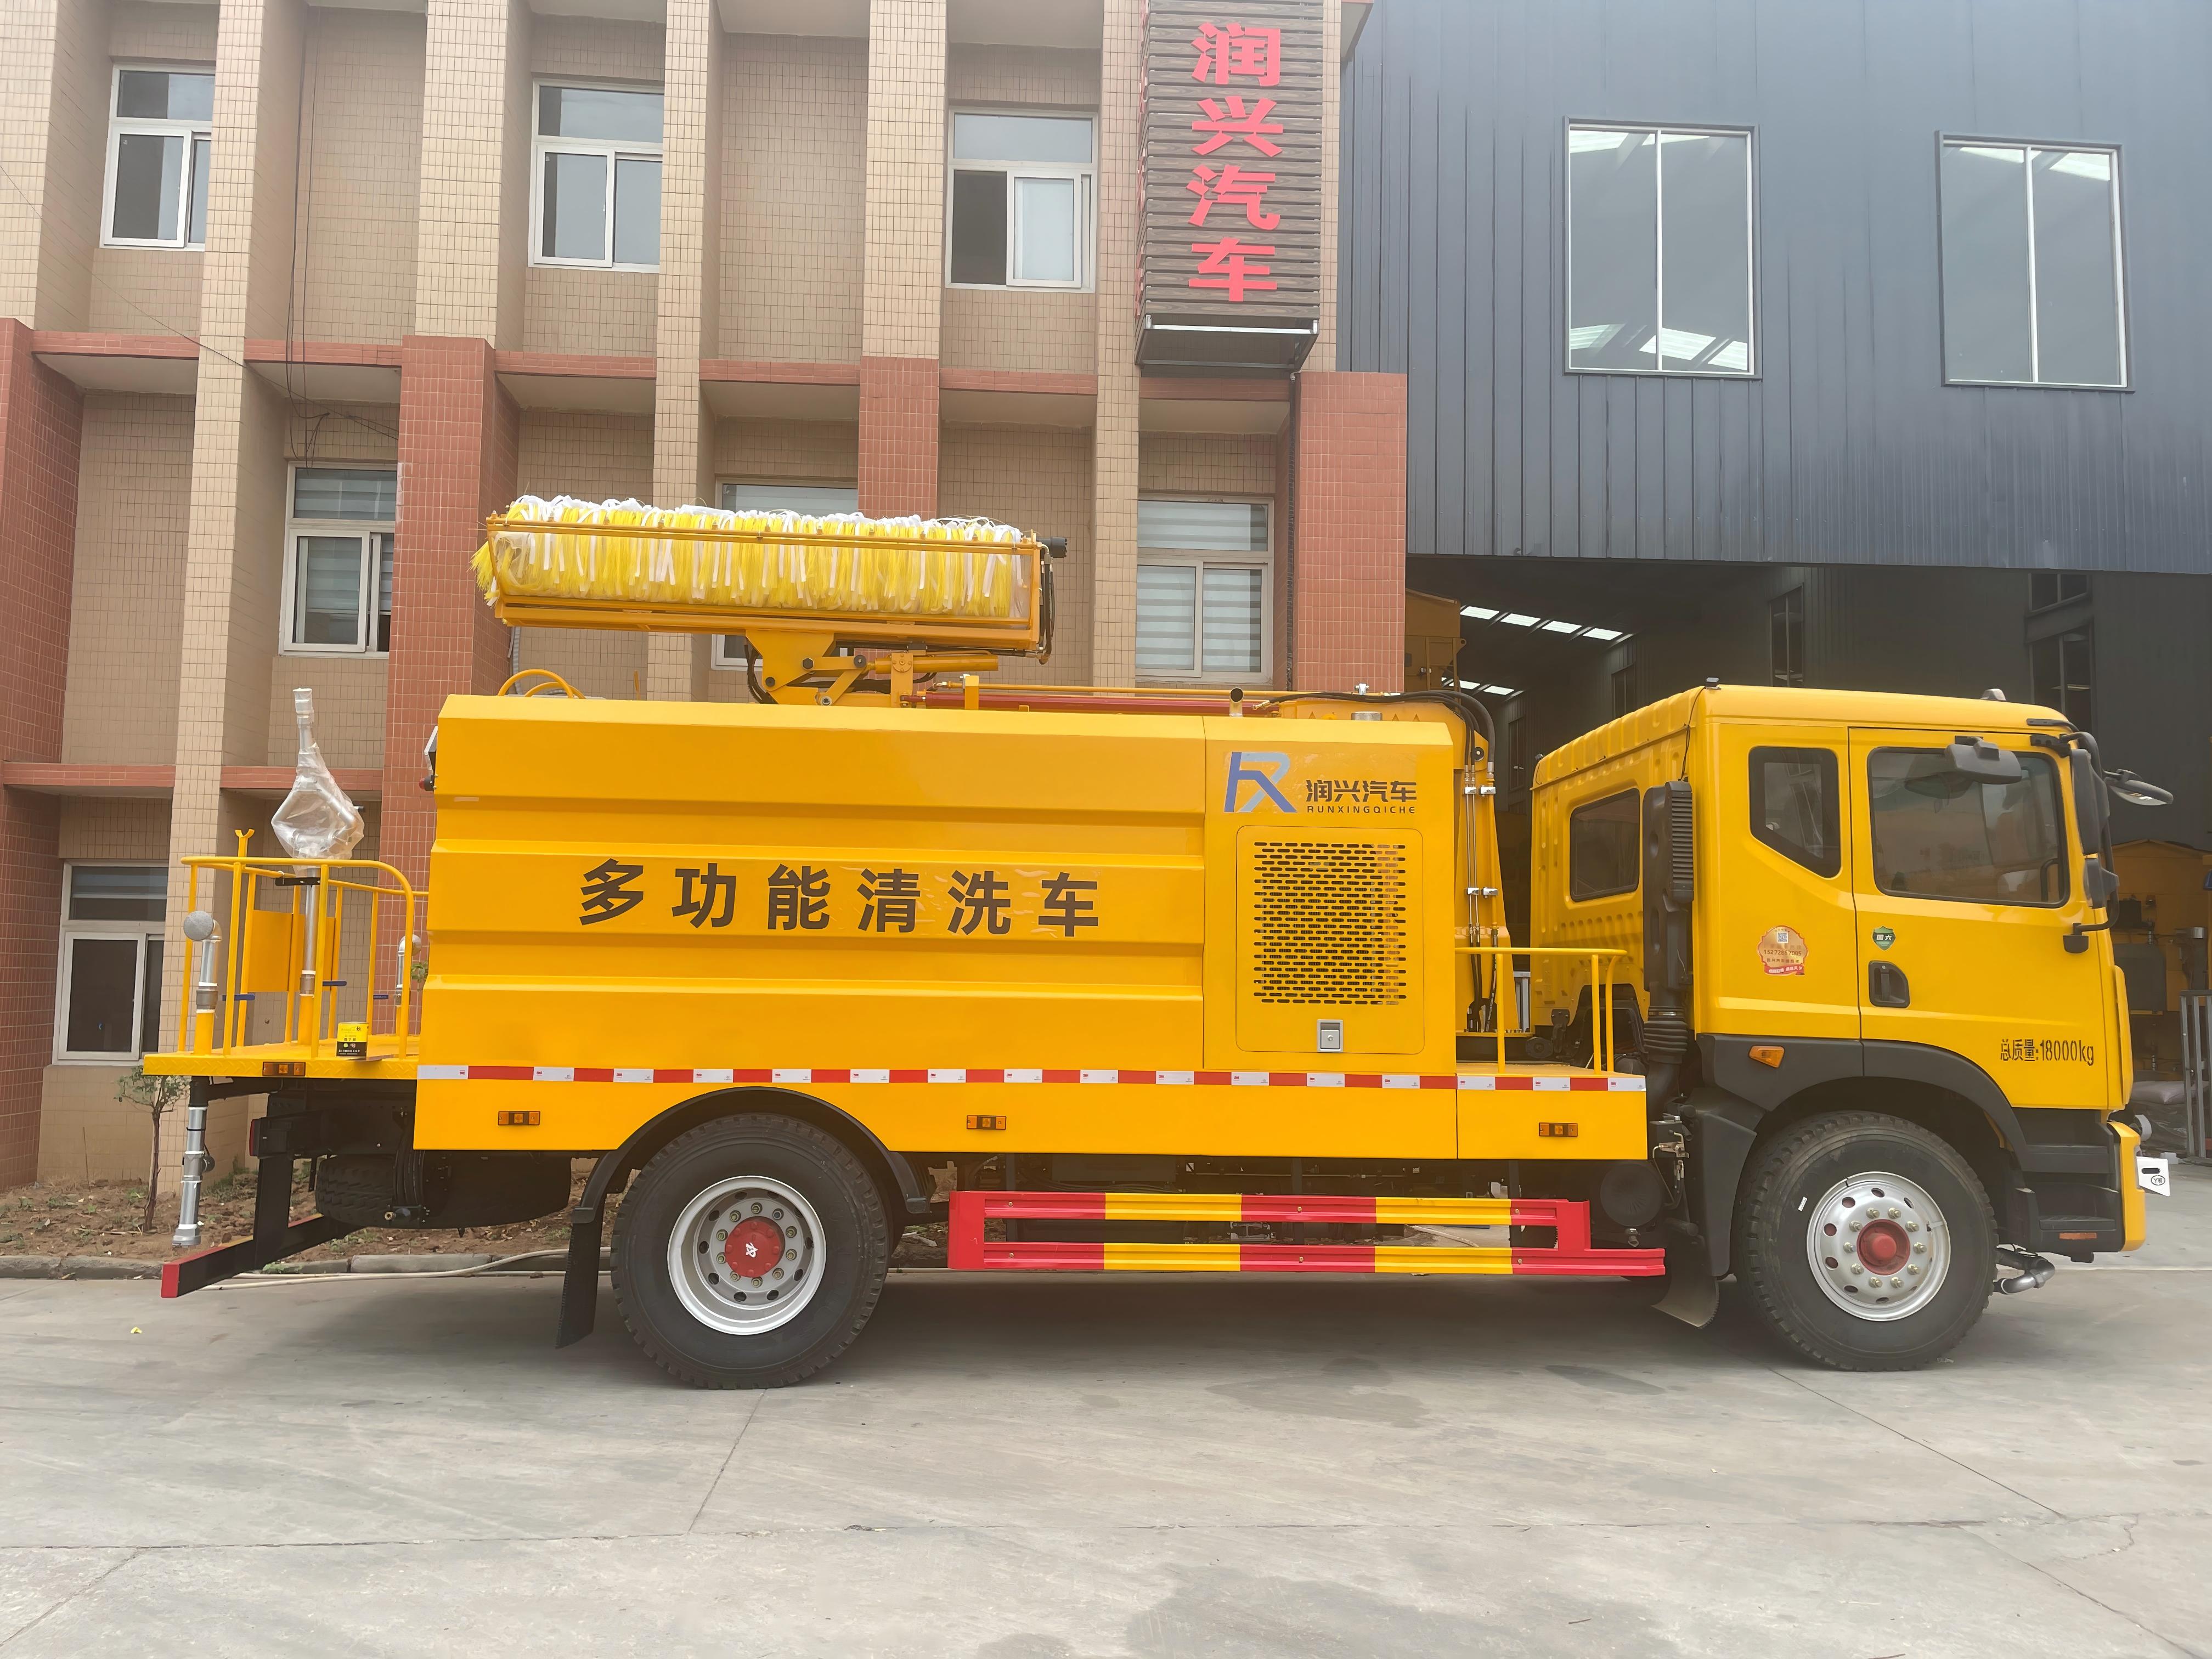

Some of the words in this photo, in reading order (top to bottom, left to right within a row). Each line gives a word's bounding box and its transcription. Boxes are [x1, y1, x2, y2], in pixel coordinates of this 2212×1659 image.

[1186, 22, 1283, 302] 润兴汽车
[1306, 780, 1417, 803] 润兴汽车
[1307, 805, 1415, 814] RUNXINGQICHE
[579, 857, 1099, 937] 多功能清洗车
